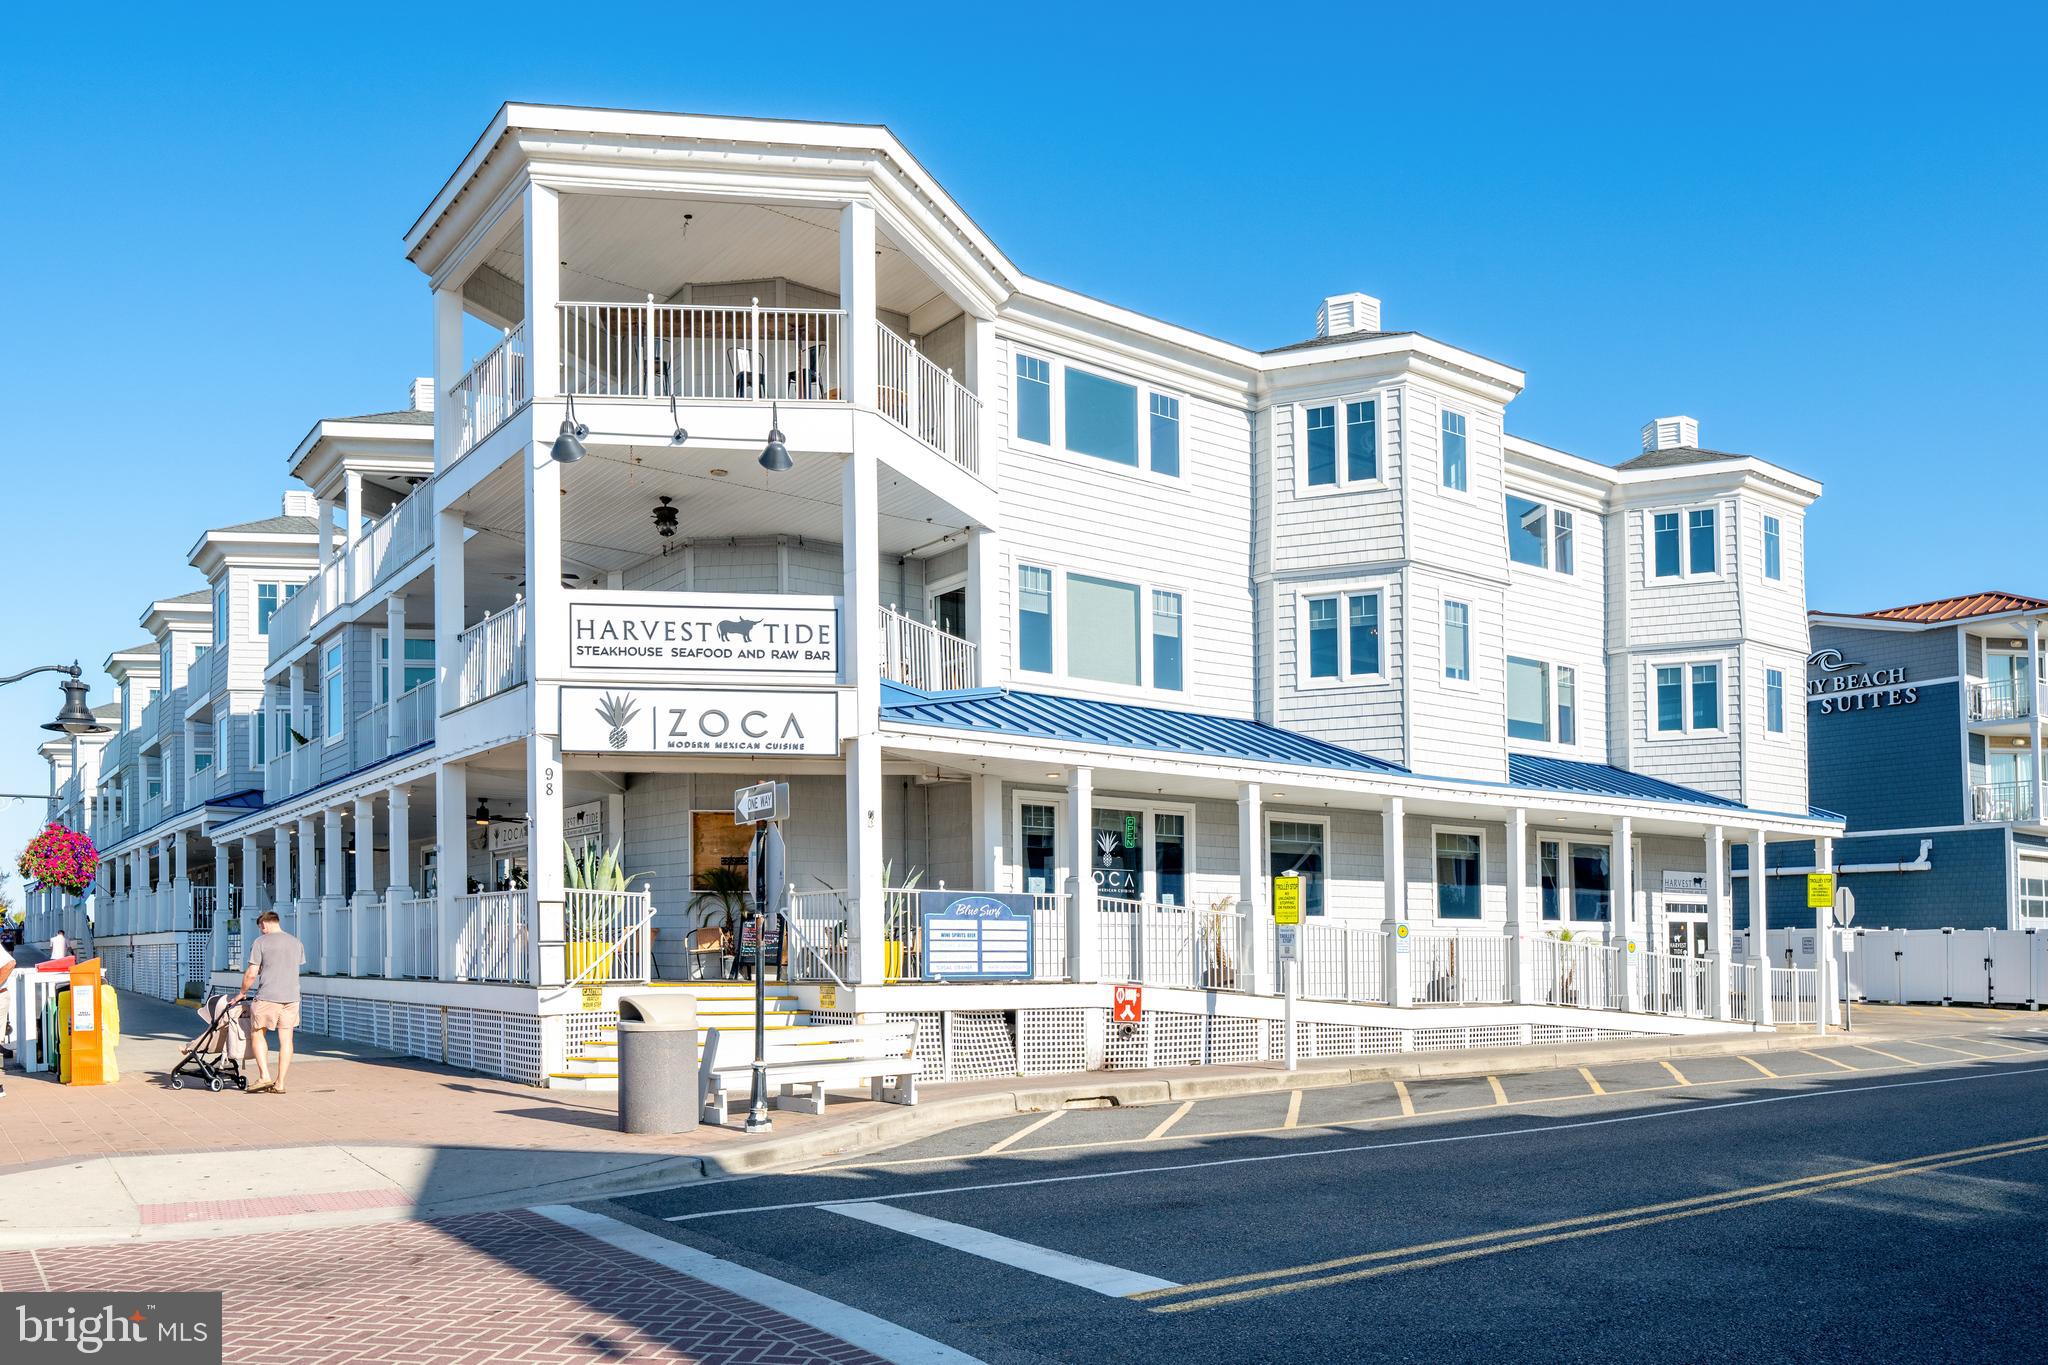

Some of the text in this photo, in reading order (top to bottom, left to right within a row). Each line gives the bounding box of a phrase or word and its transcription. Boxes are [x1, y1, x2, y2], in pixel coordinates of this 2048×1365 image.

[577, 619, 831, 645] HARVEST TIDE
[577, 645, 831, 661] STEAKHOUSE SEAFOOD AND RAW BAR
[1833, 667, 1906, 692] BEACH
[1821, 687, 1918, 715] SUITES
[668, 708, 805, 739] ZOCA
[667, 740, 805, 751] MODERN MEXICAN CUISINE
[747, 793, 772, 810] ONE WAY
[503, 827, 524, 842] ZOCA
[1092, 870, 1135, 888] OCA
[1664, 877, 1692, 889] HARVEST
[955, 903, 1002, 917] Blue Surf
